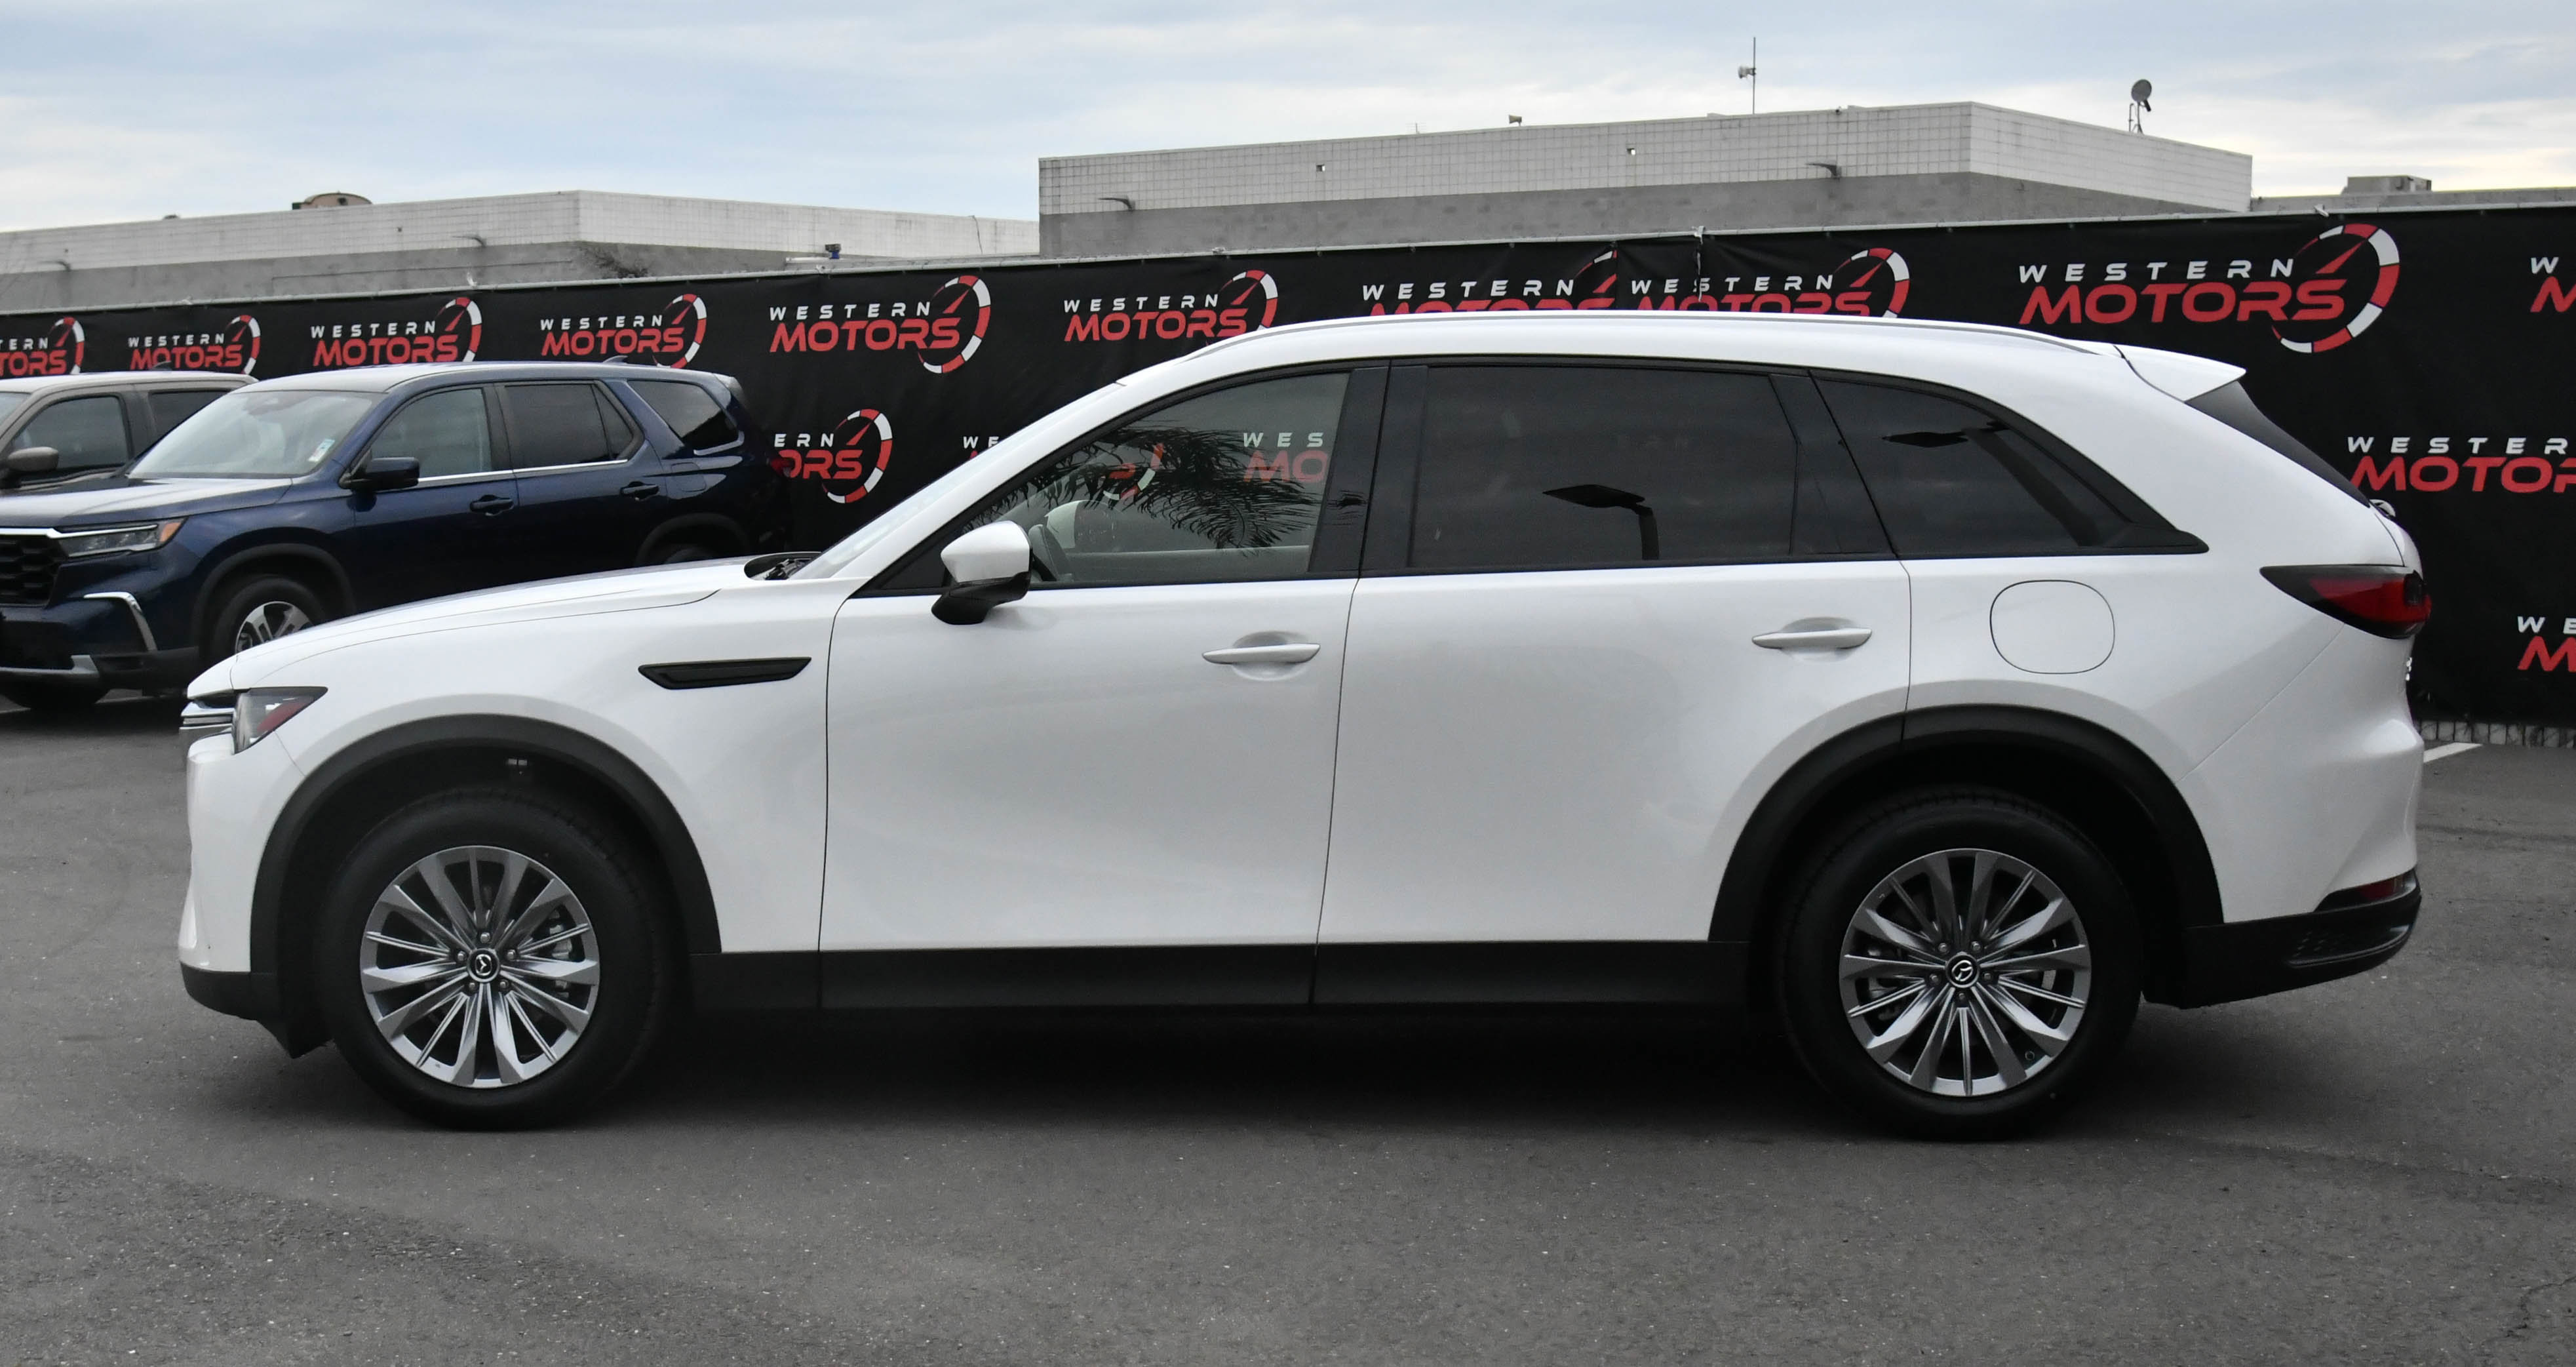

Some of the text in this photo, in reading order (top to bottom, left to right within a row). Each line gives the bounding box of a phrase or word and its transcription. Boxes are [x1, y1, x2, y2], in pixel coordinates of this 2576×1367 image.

[2019, 258, 2293, 283] WESTERN
[1363, 279, 1574, 301] WESTERN
[1631, 274, 1834, 295] WESTERN
[770, 302, 930, 321] WESTERN
[1064, 294, 1219, 313] WESTERN
[2018, 279, 2347, 325] MOTORS
[311, 321, 435, 338] WESTERN
[540, 314, 663, 331] WESTERN
[1064, 307, 1249, 342] MOTORS
[0, 338, 49, 351] ERN
[128, 333, 224, 347] WESTERN
[541, 327, 684, 356] MOTORS
[770, 317, 961, 352] MOTORS
[130, 344, 243, 370] MOTORS
[313, 334, 459, 367] MOTORS
[2348, 437, 2568, 454] WESTER
